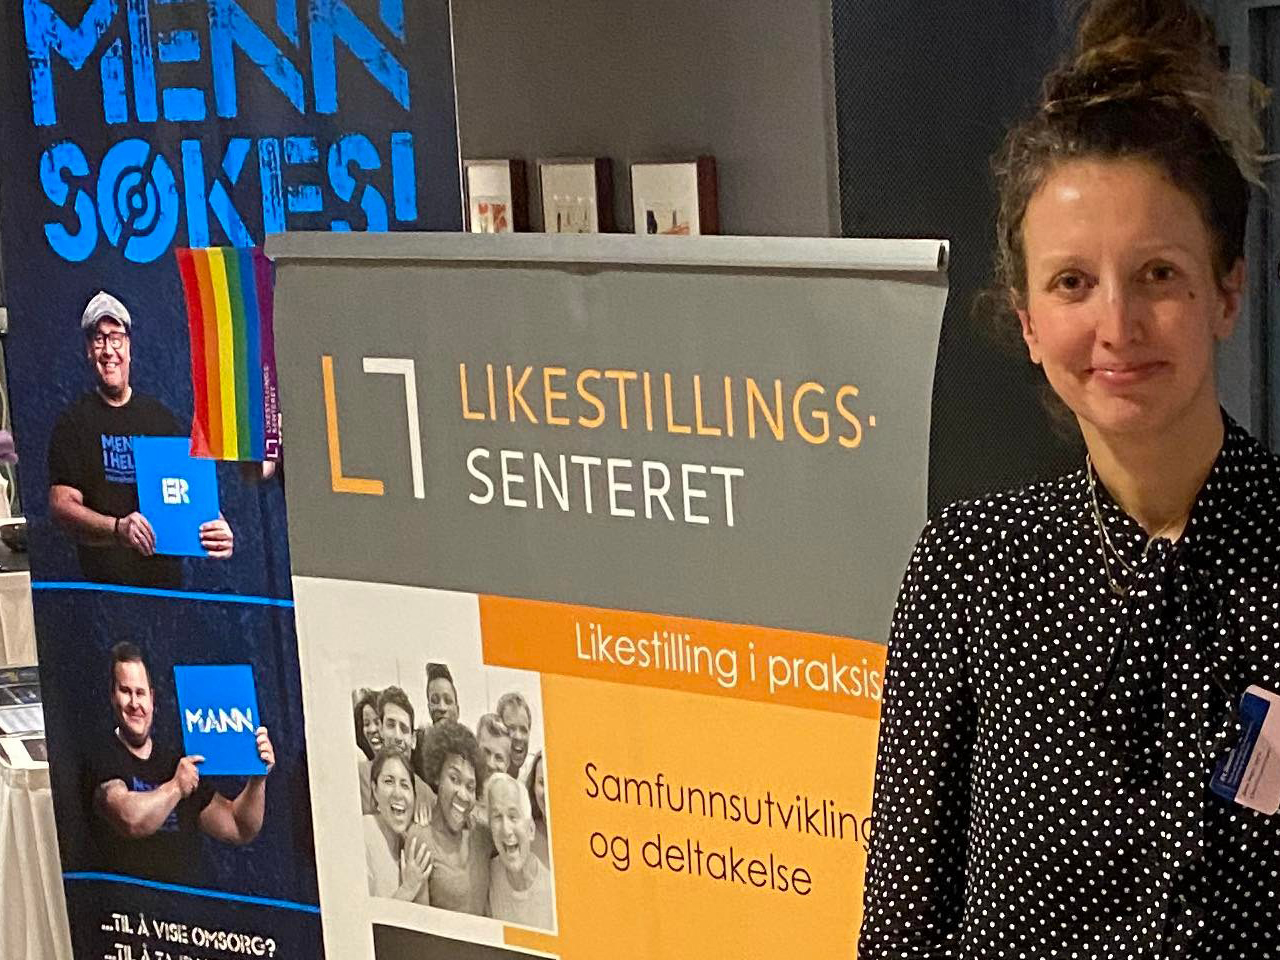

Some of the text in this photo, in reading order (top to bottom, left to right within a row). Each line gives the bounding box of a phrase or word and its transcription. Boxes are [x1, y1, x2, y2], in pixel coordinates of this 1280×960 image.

[26, 0, 410, 125] MENN
[466, 447, 744, 527] SENTERET
[575, 621, 882, 701] Likestilling i praksis
[185, 707, 254, 733] MANN
[590, 831, 812, 896] og deltakelse
[136, 913, 151, 936] Å
[152, 919, 188, 944] VISE
[191, 927, 277, 958] OMSORG?
